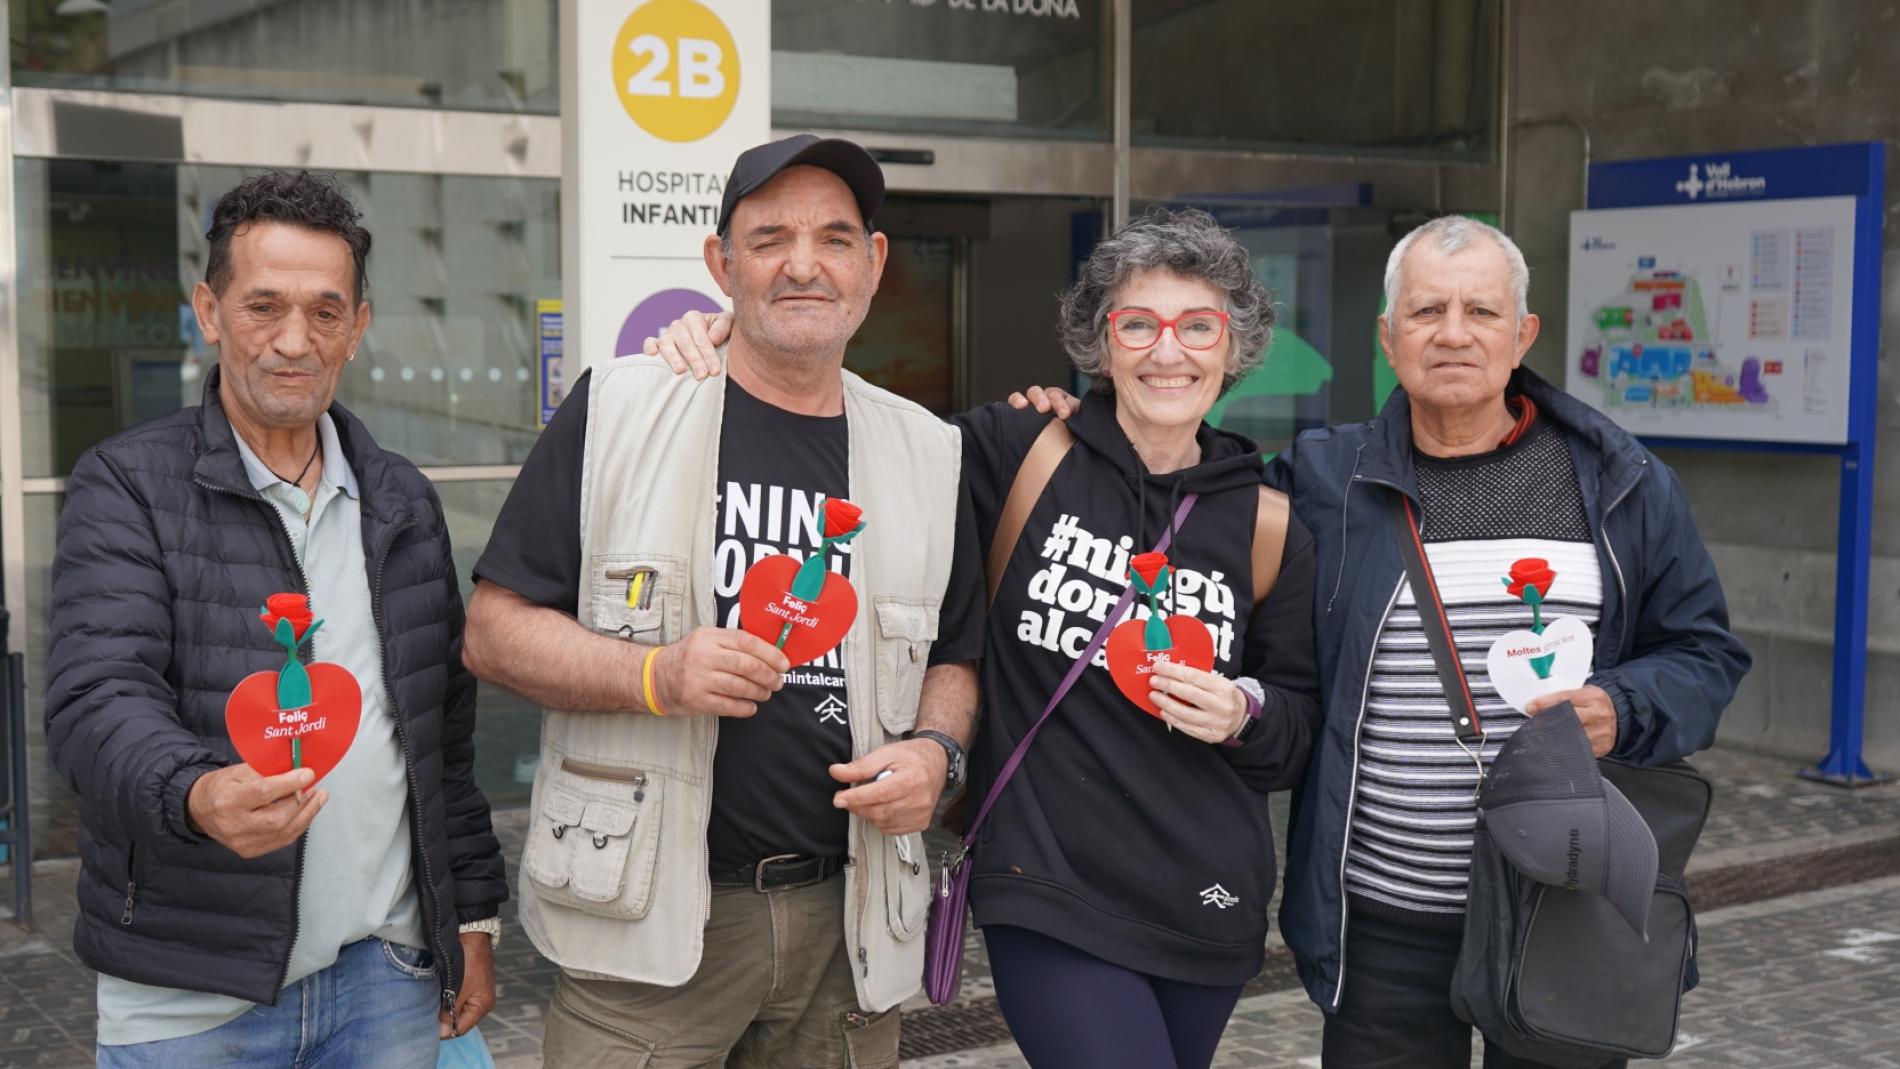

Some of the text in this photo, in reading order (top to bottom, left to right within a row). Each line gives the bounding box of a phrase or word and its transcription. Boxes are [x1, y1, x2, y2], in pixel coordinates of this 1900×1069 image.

[627, 34, 725, 98] 2B
[618, 170, 728, 195] HOSPITA
[622, 203, 718, 225] INFANTI
[765, 602, 820, 628] Sant Jordi
[1507, 647, 1542, 657] Moltes
[1135, 664, 1153, 675] San
[264, 716, 326, 739] Sant Jordi
[278, 710, 308, 723] Feliç
